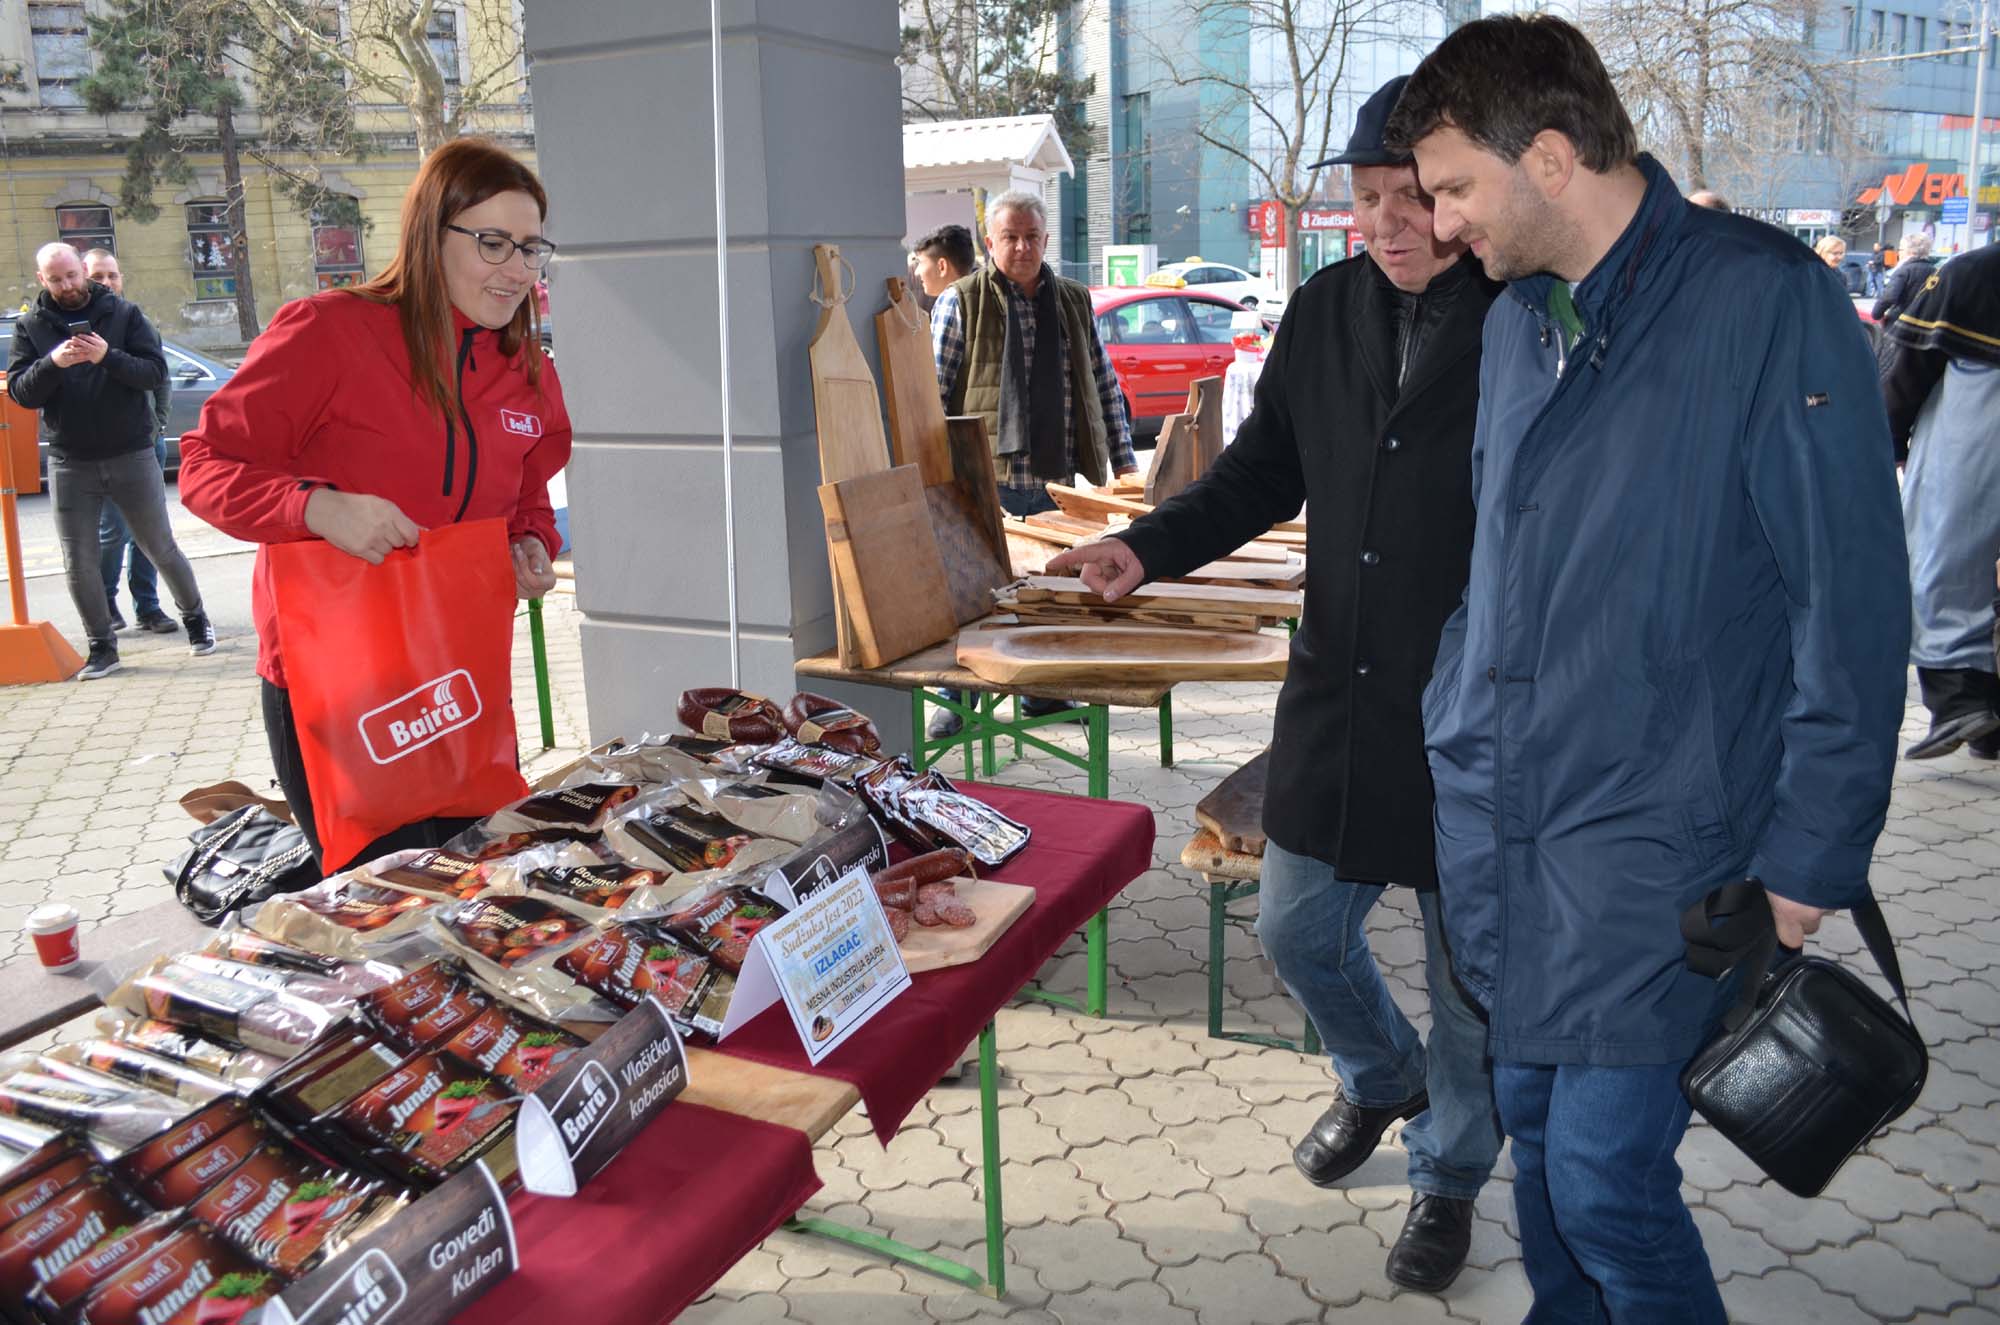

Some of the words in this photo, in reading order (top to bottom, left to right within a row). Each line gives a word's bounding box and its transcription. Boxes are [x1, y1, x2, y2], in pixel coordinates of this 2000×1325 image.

[509, 417, 534, 434] Bajra
[388, 700, 463, 748] Bajra
[699, 896, 737, 933] Juneti
[781, 918, 825, 959] Sudžuka
[824, 906, 841, 933] fest
[840, 888, 865, 914] 2022
[613, 940, 645, 988] Juneti
[805, 987, 832, 1010] MESNA
[864, 944, 886, 965] BAJRA
[814, 931, 861, 977] IZLAGAČ
[841, 983, 868, 1007] TRAVNIK
[477, 1023, 521, 1072] Juneti
[388, 1070, 444, 1128] Juneti
[562, 1087, 607, 1145] Bajra
[629, 1064, 680, 1121] kobasica
[428, 1206, 496, 1271] Goveđi
[452, 1246, 504, 1297] Kulen
